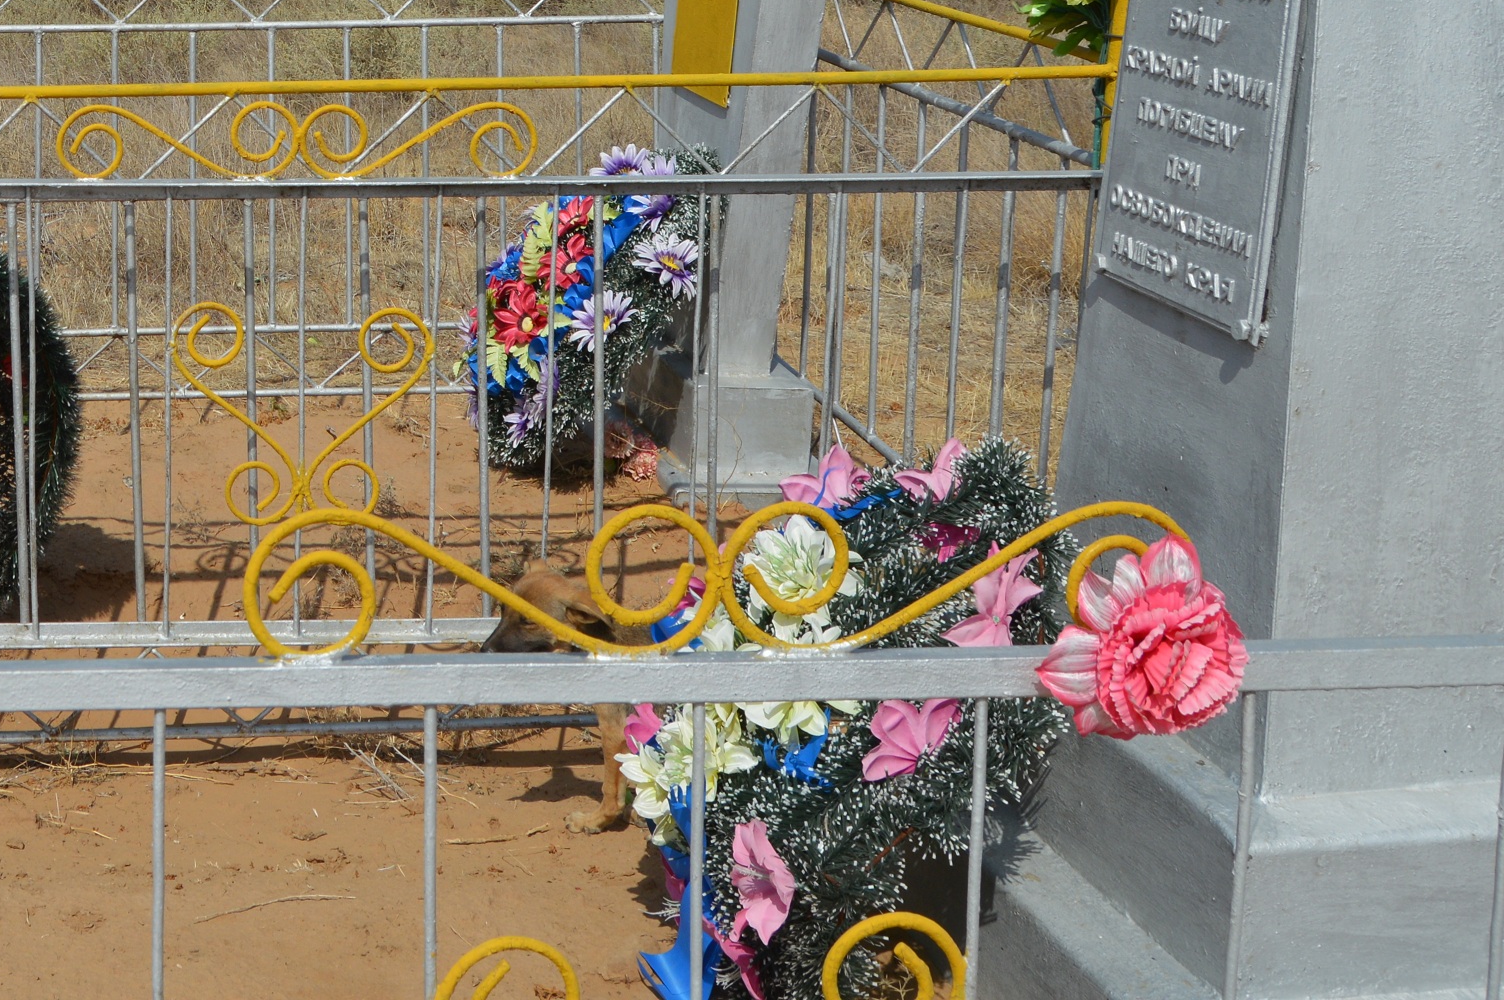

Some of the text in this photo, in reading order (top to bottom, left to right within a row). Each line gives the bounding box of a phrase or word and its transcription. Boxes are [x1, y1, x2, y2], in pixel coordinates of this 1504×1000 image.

[1169, 6, 1230, 43] БОЙЦУ
[1125, 44, 1273, 106] КРАСНОЙ АРМИИ
[1137, 96, 1245, 148] ПОГИБШЕМУ
[1165, 154, 1201, 187] ПРИ
[1111, 183, 1253, 257] ОСВОБОЖДЕНИИ
[1112, 231, 1236, 303] НАШЕГО КРАЯ
